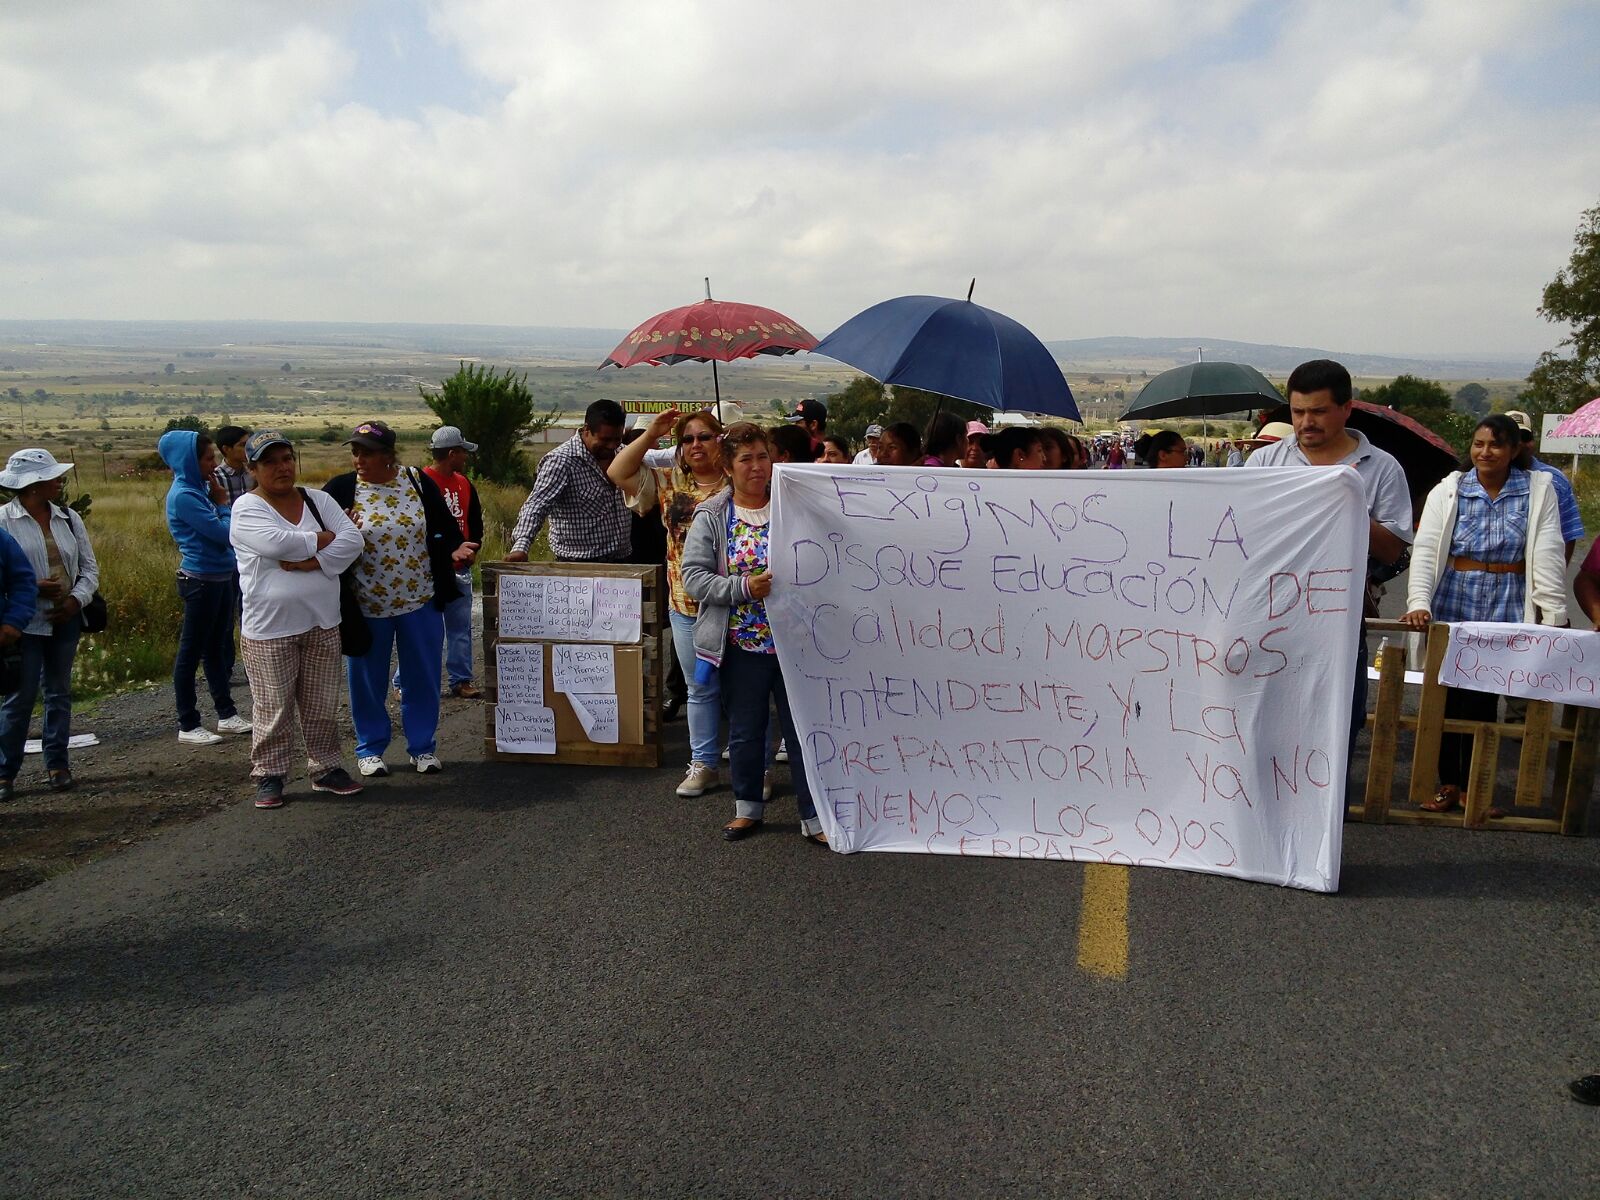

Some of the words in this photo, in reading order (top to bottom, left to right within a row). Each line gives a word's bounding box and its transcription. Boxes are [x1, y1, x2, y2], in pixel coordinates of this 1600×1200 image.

[624, 402, 672, 412] ULTIMOS
[676, 402, 702, 412] TRES
[1168, 501, 1249, 560] LA
[1266, 568, 1353, 621] DE
[1454, 646, 1600, 695] Respuesta
[1169, 678, 1246, 755] La
[806, 731, 1148, 793] PREPARATORIA
[1271, 745, 1331, 801] NO
[1031, 797, 1114, 846] LOS
